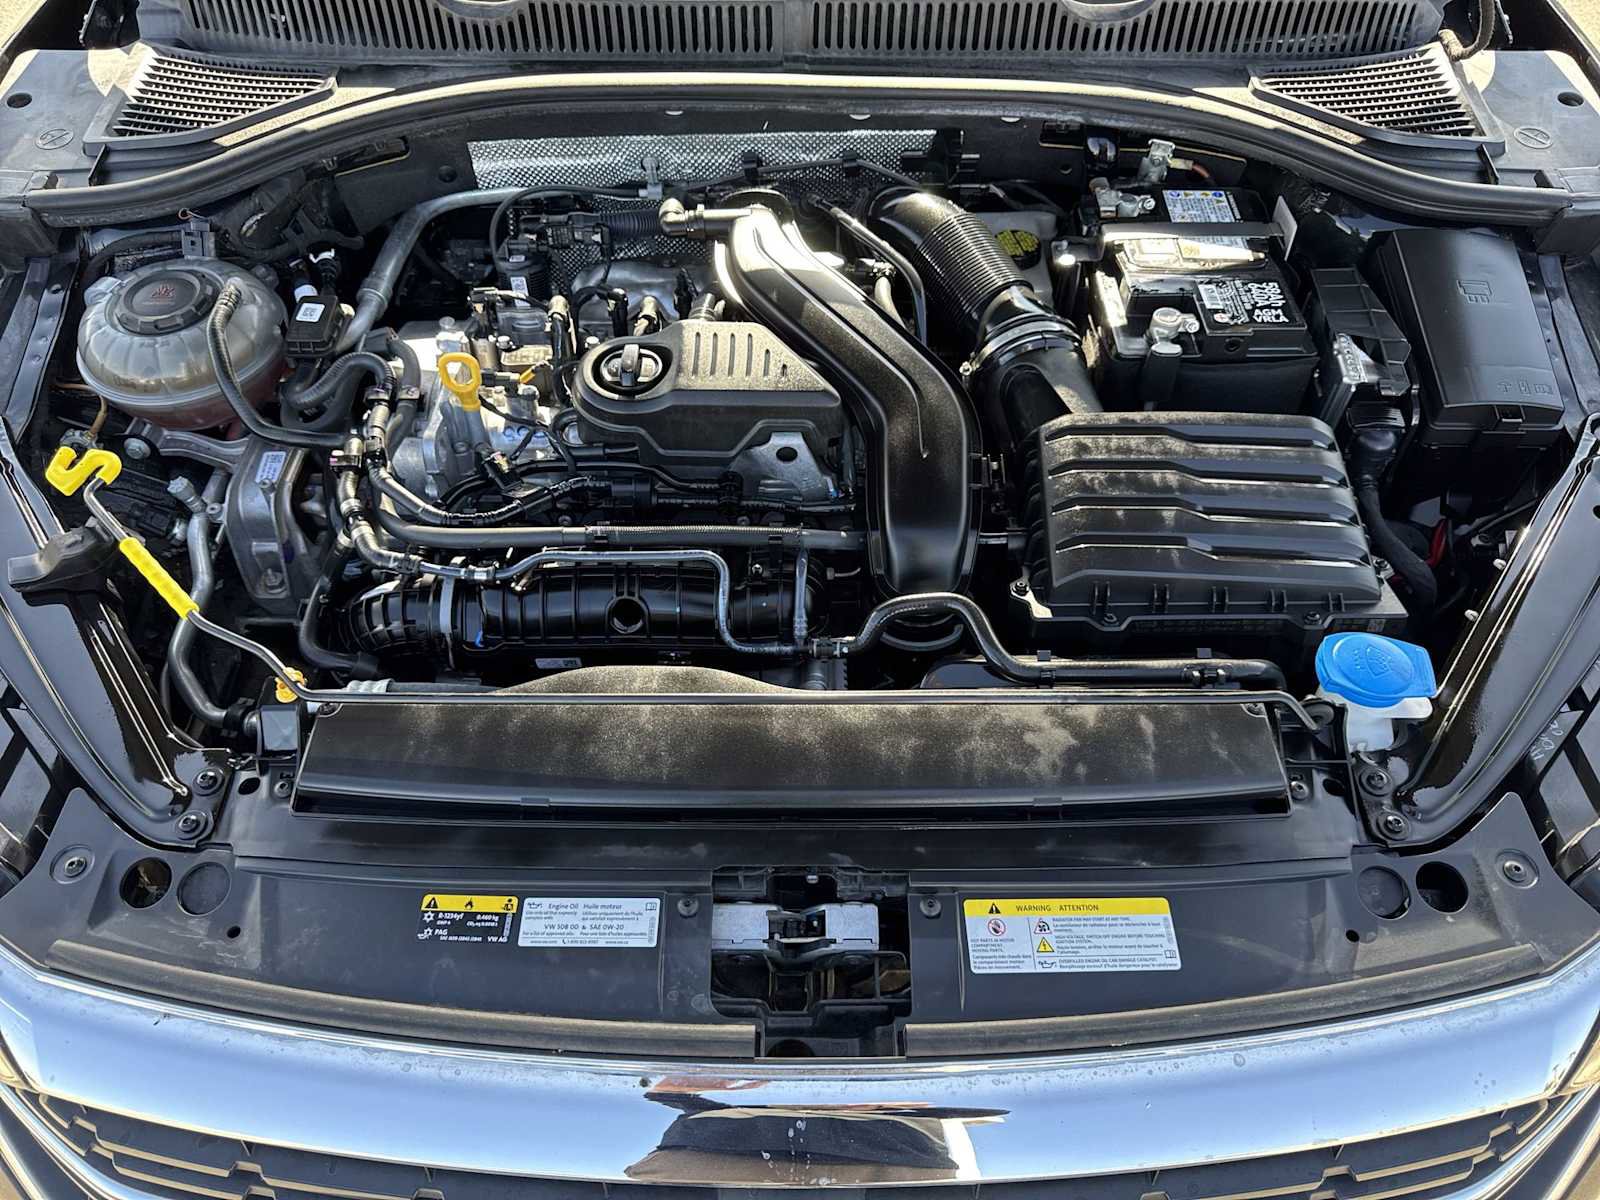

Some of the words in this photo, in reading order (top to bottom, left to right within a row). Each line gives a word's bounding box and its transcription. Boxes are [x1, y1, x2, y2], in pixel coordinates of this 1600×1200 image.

[1262, 282, 1286, 307] 58Ah
[1252, 315, 1289, 323] VRLA
[548, 903, 569, 911] Engine
[1015, 904, 1052, 912] WARNING
[1059, 904, 1099, 912] ATTENTION
[438, 912, 464, 921] R-1234yf
